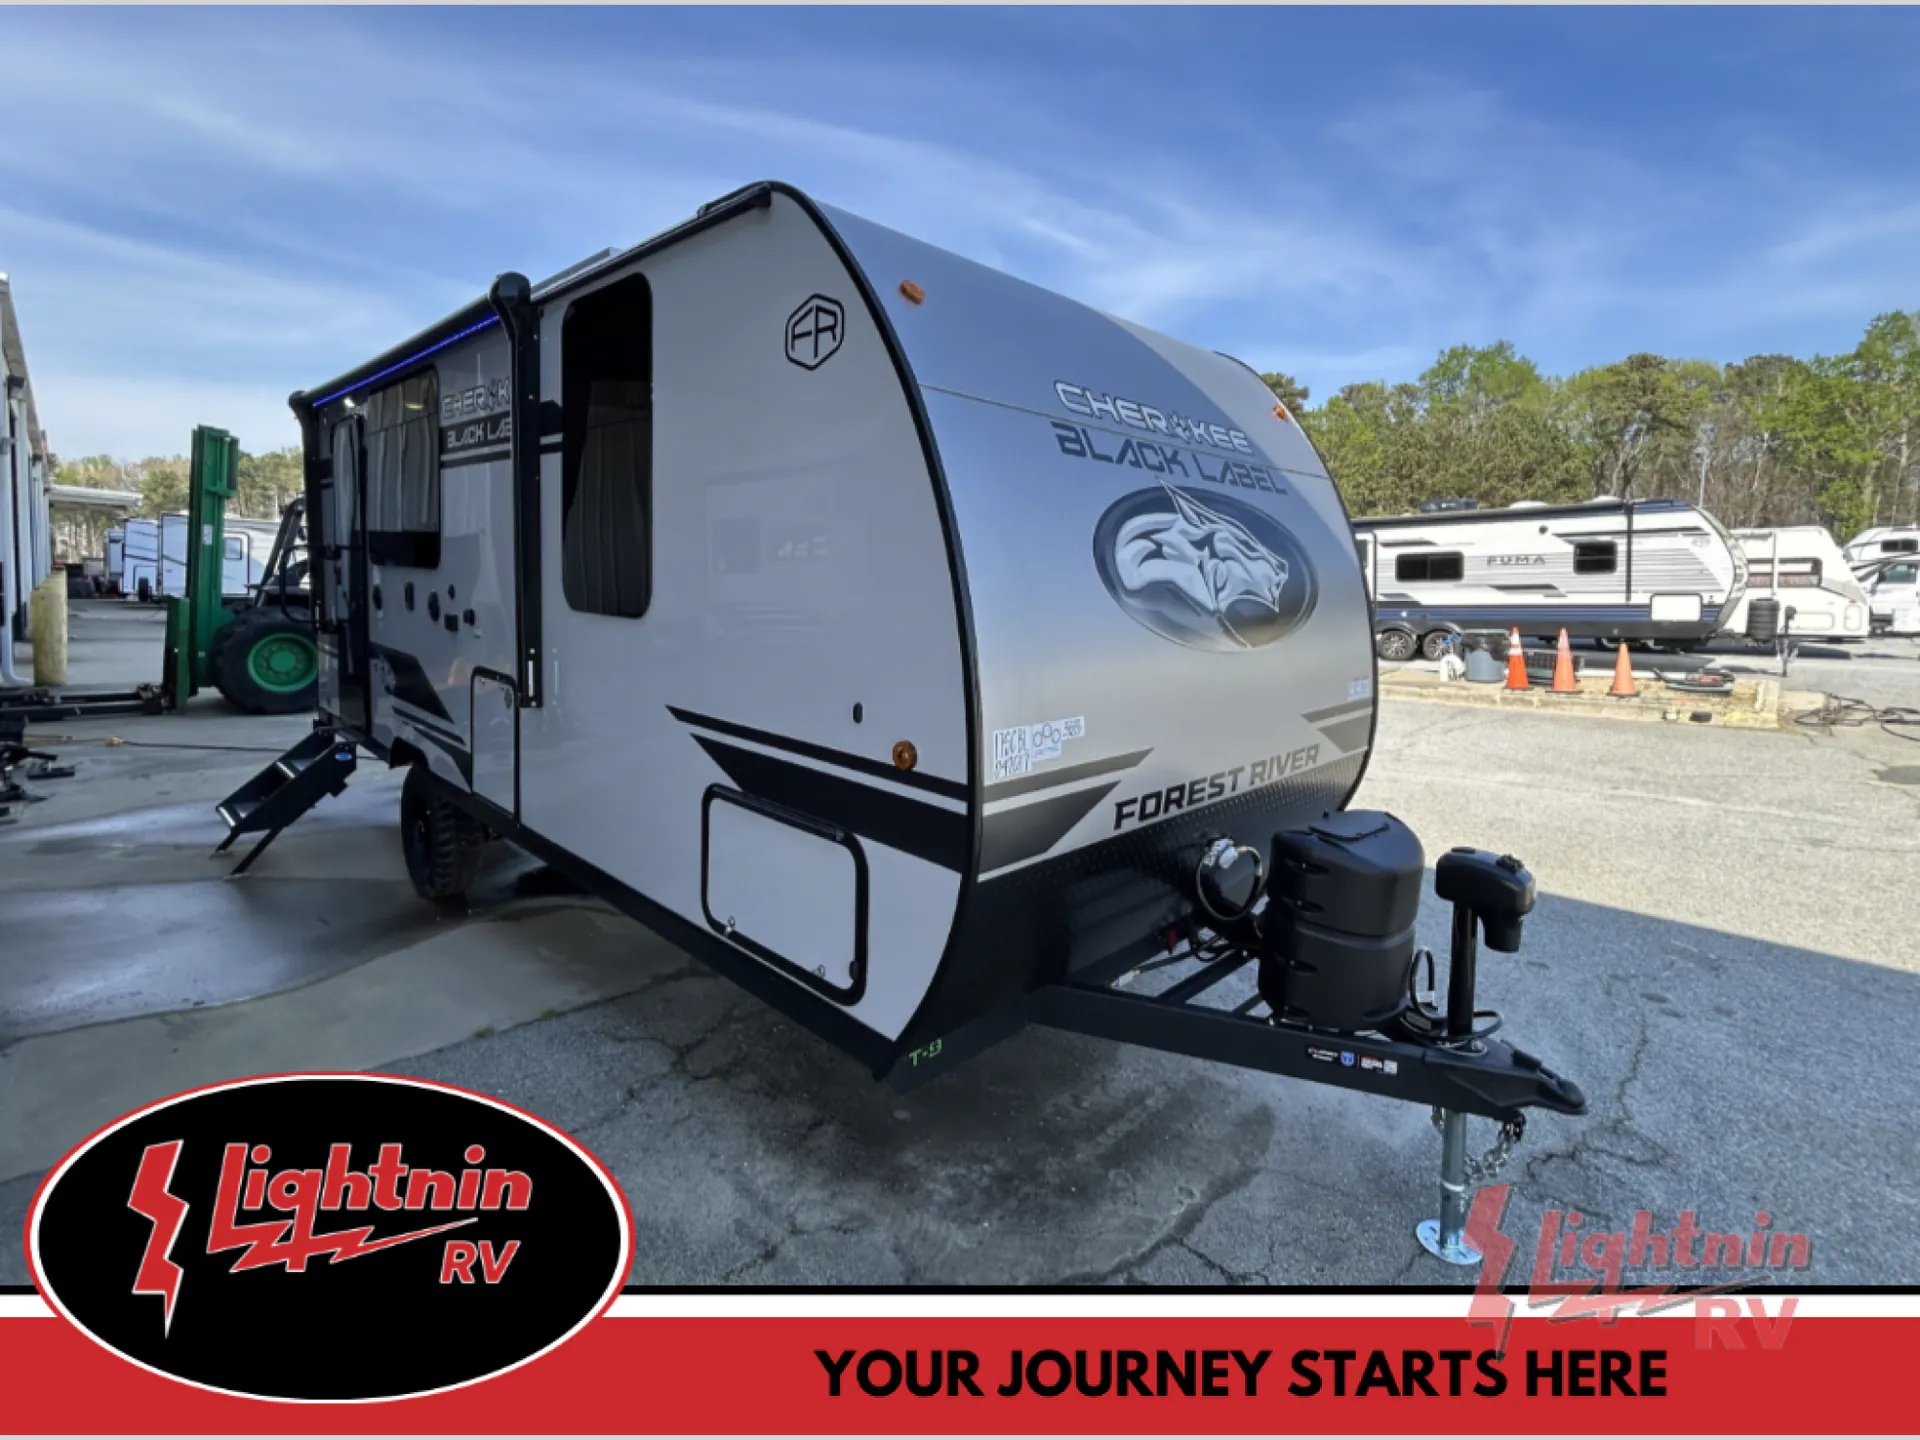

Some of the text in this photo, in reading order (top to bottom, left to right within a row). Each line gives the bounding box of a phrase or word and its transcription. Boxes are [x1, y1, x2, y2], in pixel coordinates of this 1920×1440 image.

[447, 421, 485, 449] BLACK
[1050, 421, 1290, 496] BLACK LABEL
[1114, 743, 1321, 831] FOREST RIVER
